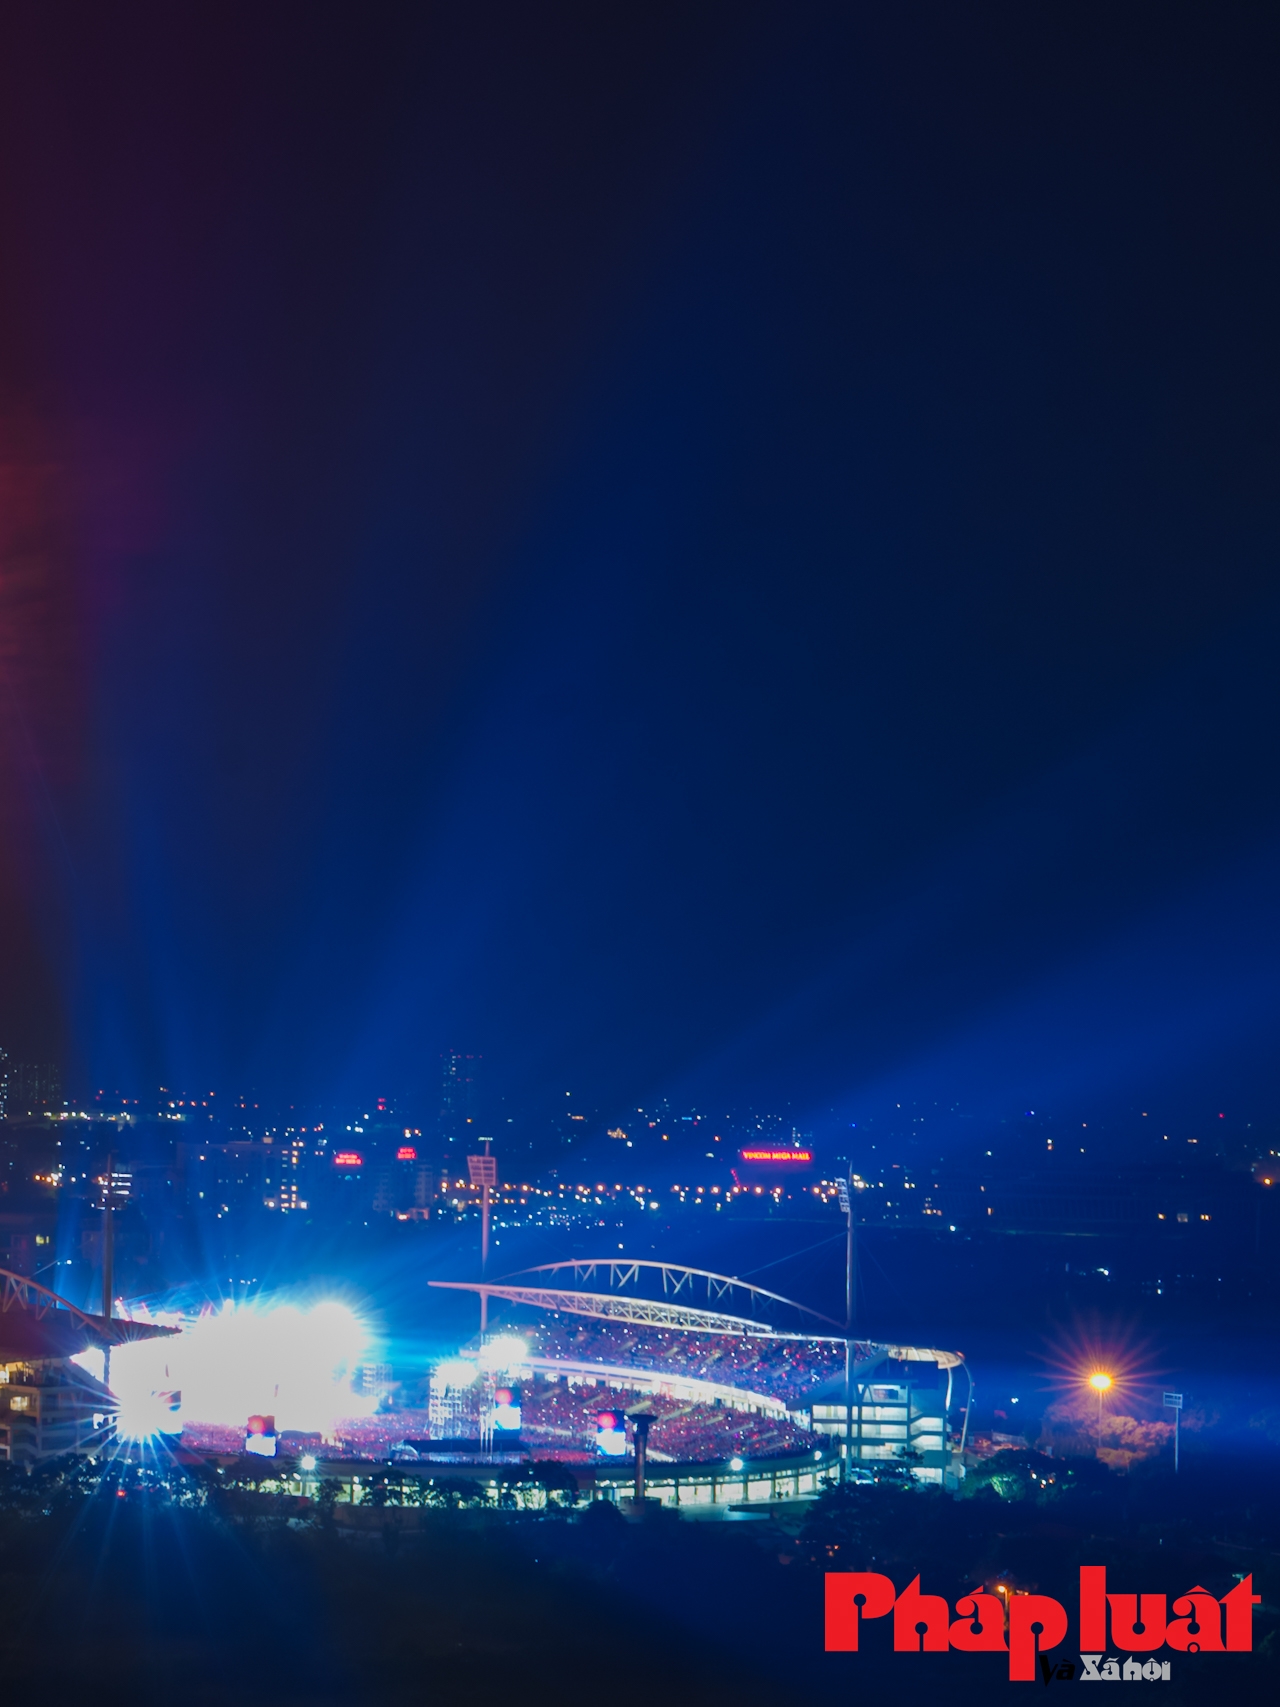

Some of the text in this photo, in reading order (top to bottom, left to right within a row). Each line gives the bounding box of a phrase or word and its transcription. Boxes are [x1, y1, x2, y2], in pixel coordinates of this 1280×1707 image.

[742, 1151, 811, 1161] VINCOM MEGA MALL
